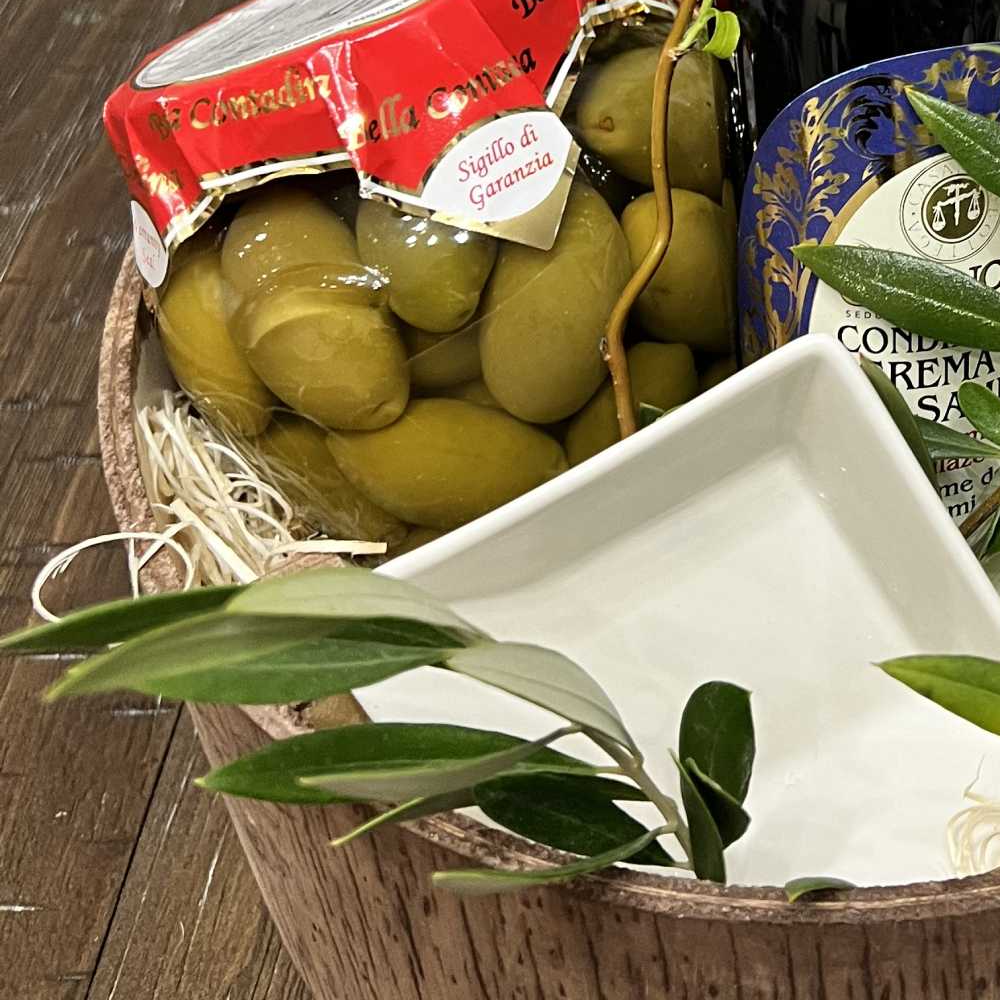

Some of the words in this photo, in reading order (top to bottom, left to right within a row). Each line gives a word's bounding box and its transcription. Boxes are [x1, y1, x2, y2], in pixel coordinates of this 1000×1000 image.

[457, 135, 516, 182] Sigillo
[520, 123, 539, 150] di
[469, 151, 554, 211] Garanzia
[872, 348, 995, 391] REMA
